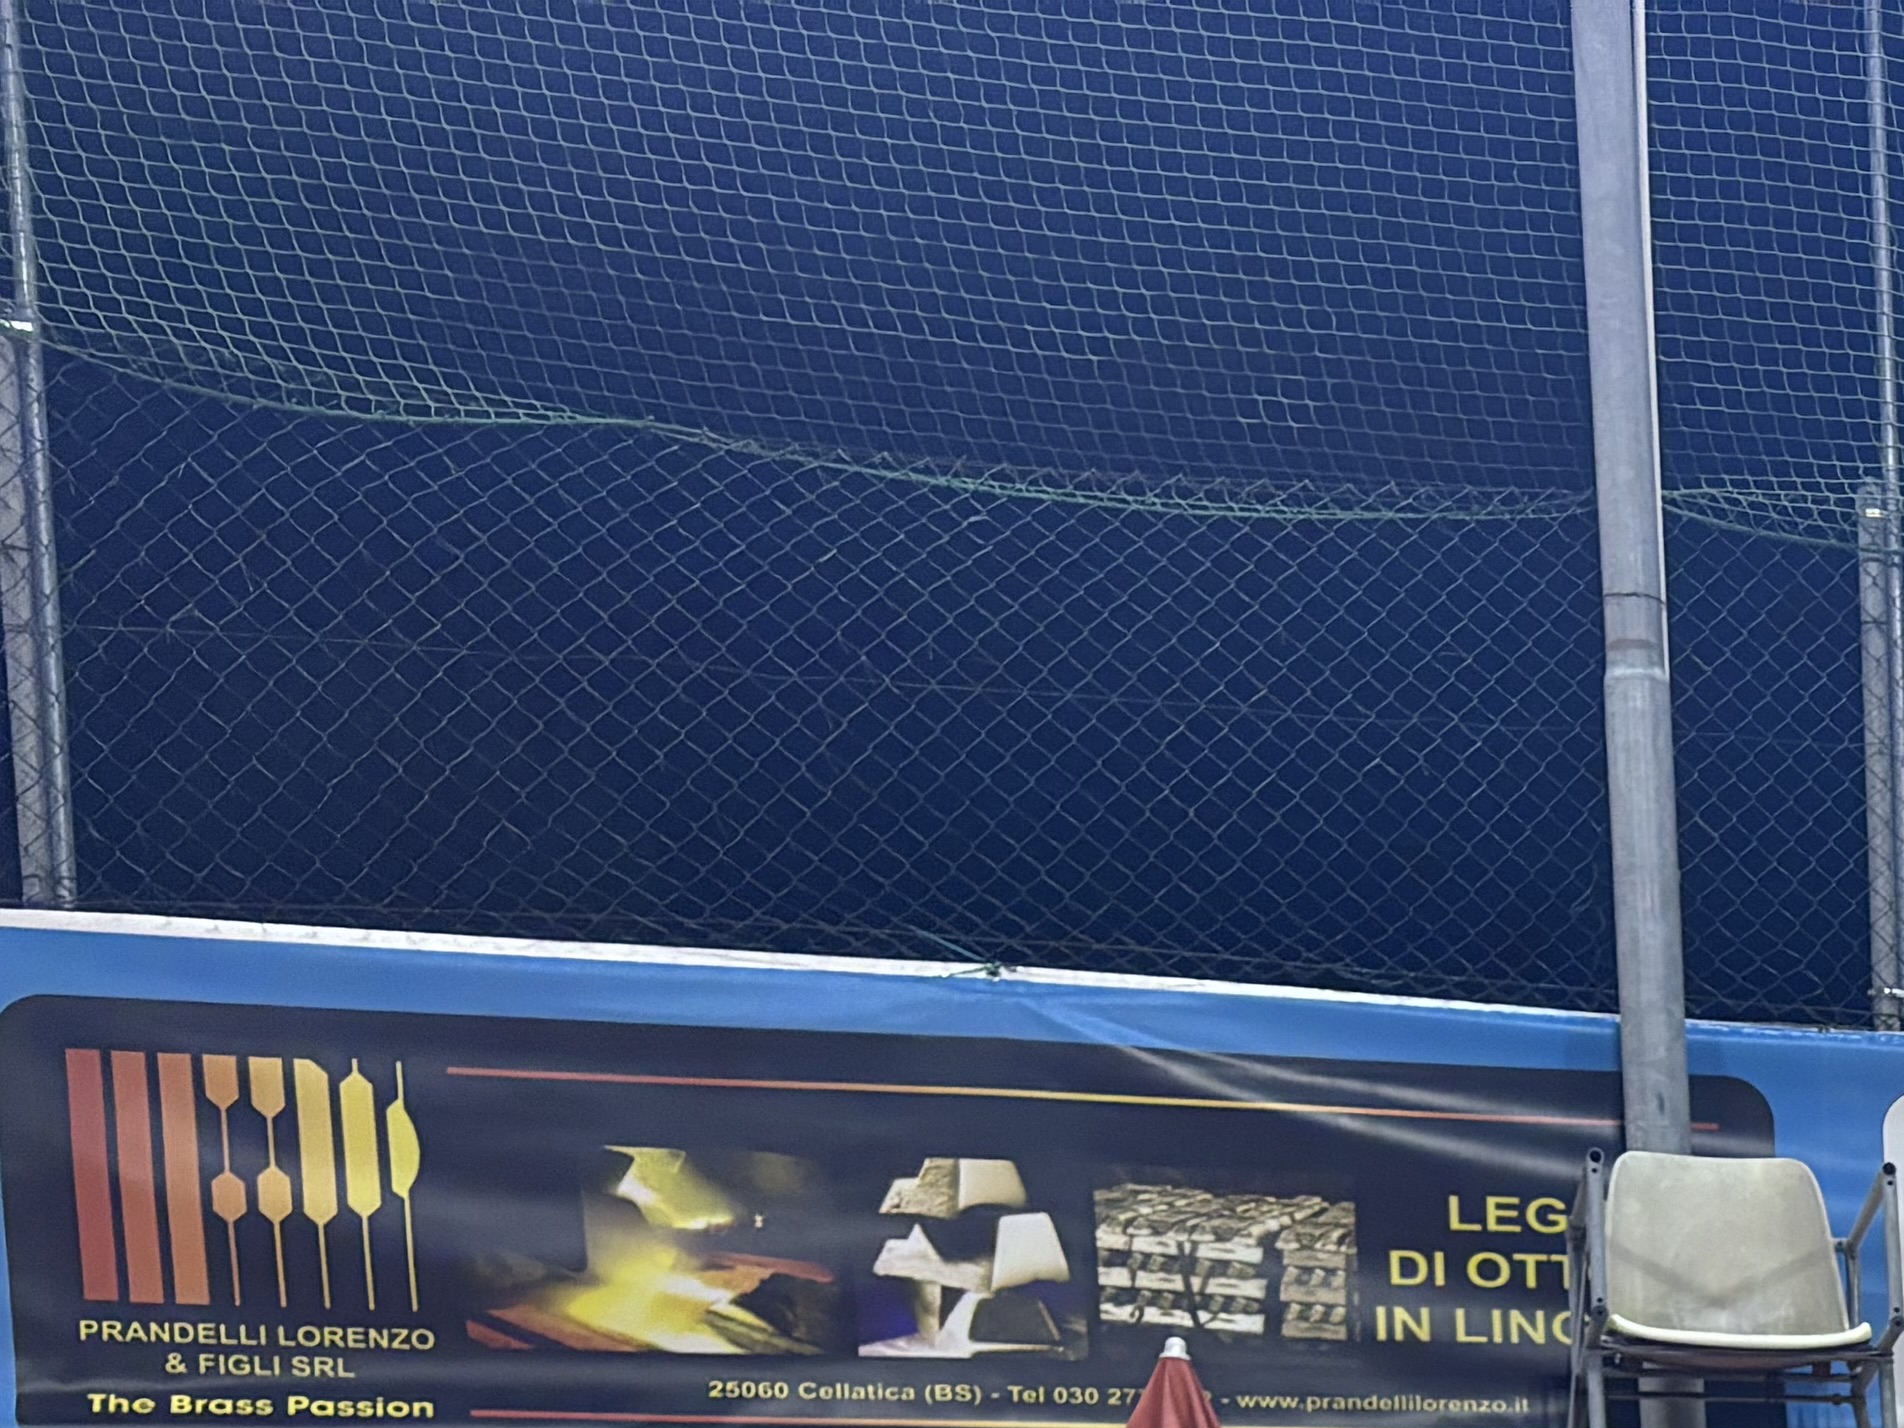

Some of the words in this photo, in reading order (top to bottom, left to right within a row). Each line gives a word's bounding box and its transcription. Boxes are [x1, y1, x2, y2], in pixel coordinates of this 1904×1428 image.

[1448, 1194, 1569, 1234] LEG
[1389, 1250, 1445, 1287] DI
[1467, 1251, 1570, 1290] OTT
[79, 1319, 267, 1345] PRANDELLI
[277, 1324, 436, 1350] LORENZO
[1376, 1305, 1430, 1342] IN
[165, 1352, 187, 1375] &
[199, 1354, 280, 1377] FIGLI
[291, 1355, 355, 1378] SRL
[87, 1392, 156, 1415] The
[170, 1394, 275, 1417] Brass
[286, 1395, 435, 1419] Passion
[708, 1380, 789, 1399] 25060
[798, 1380, 915, 1402] Cellatica
[924, 1383, 982, 1406] (BS)
[1007, 1385, 1045, 1404] Tel
[1053, 1386, 1099, 1406] 030
[1235, 1394, 1529, 1413] www.prandellilorenzo.it
